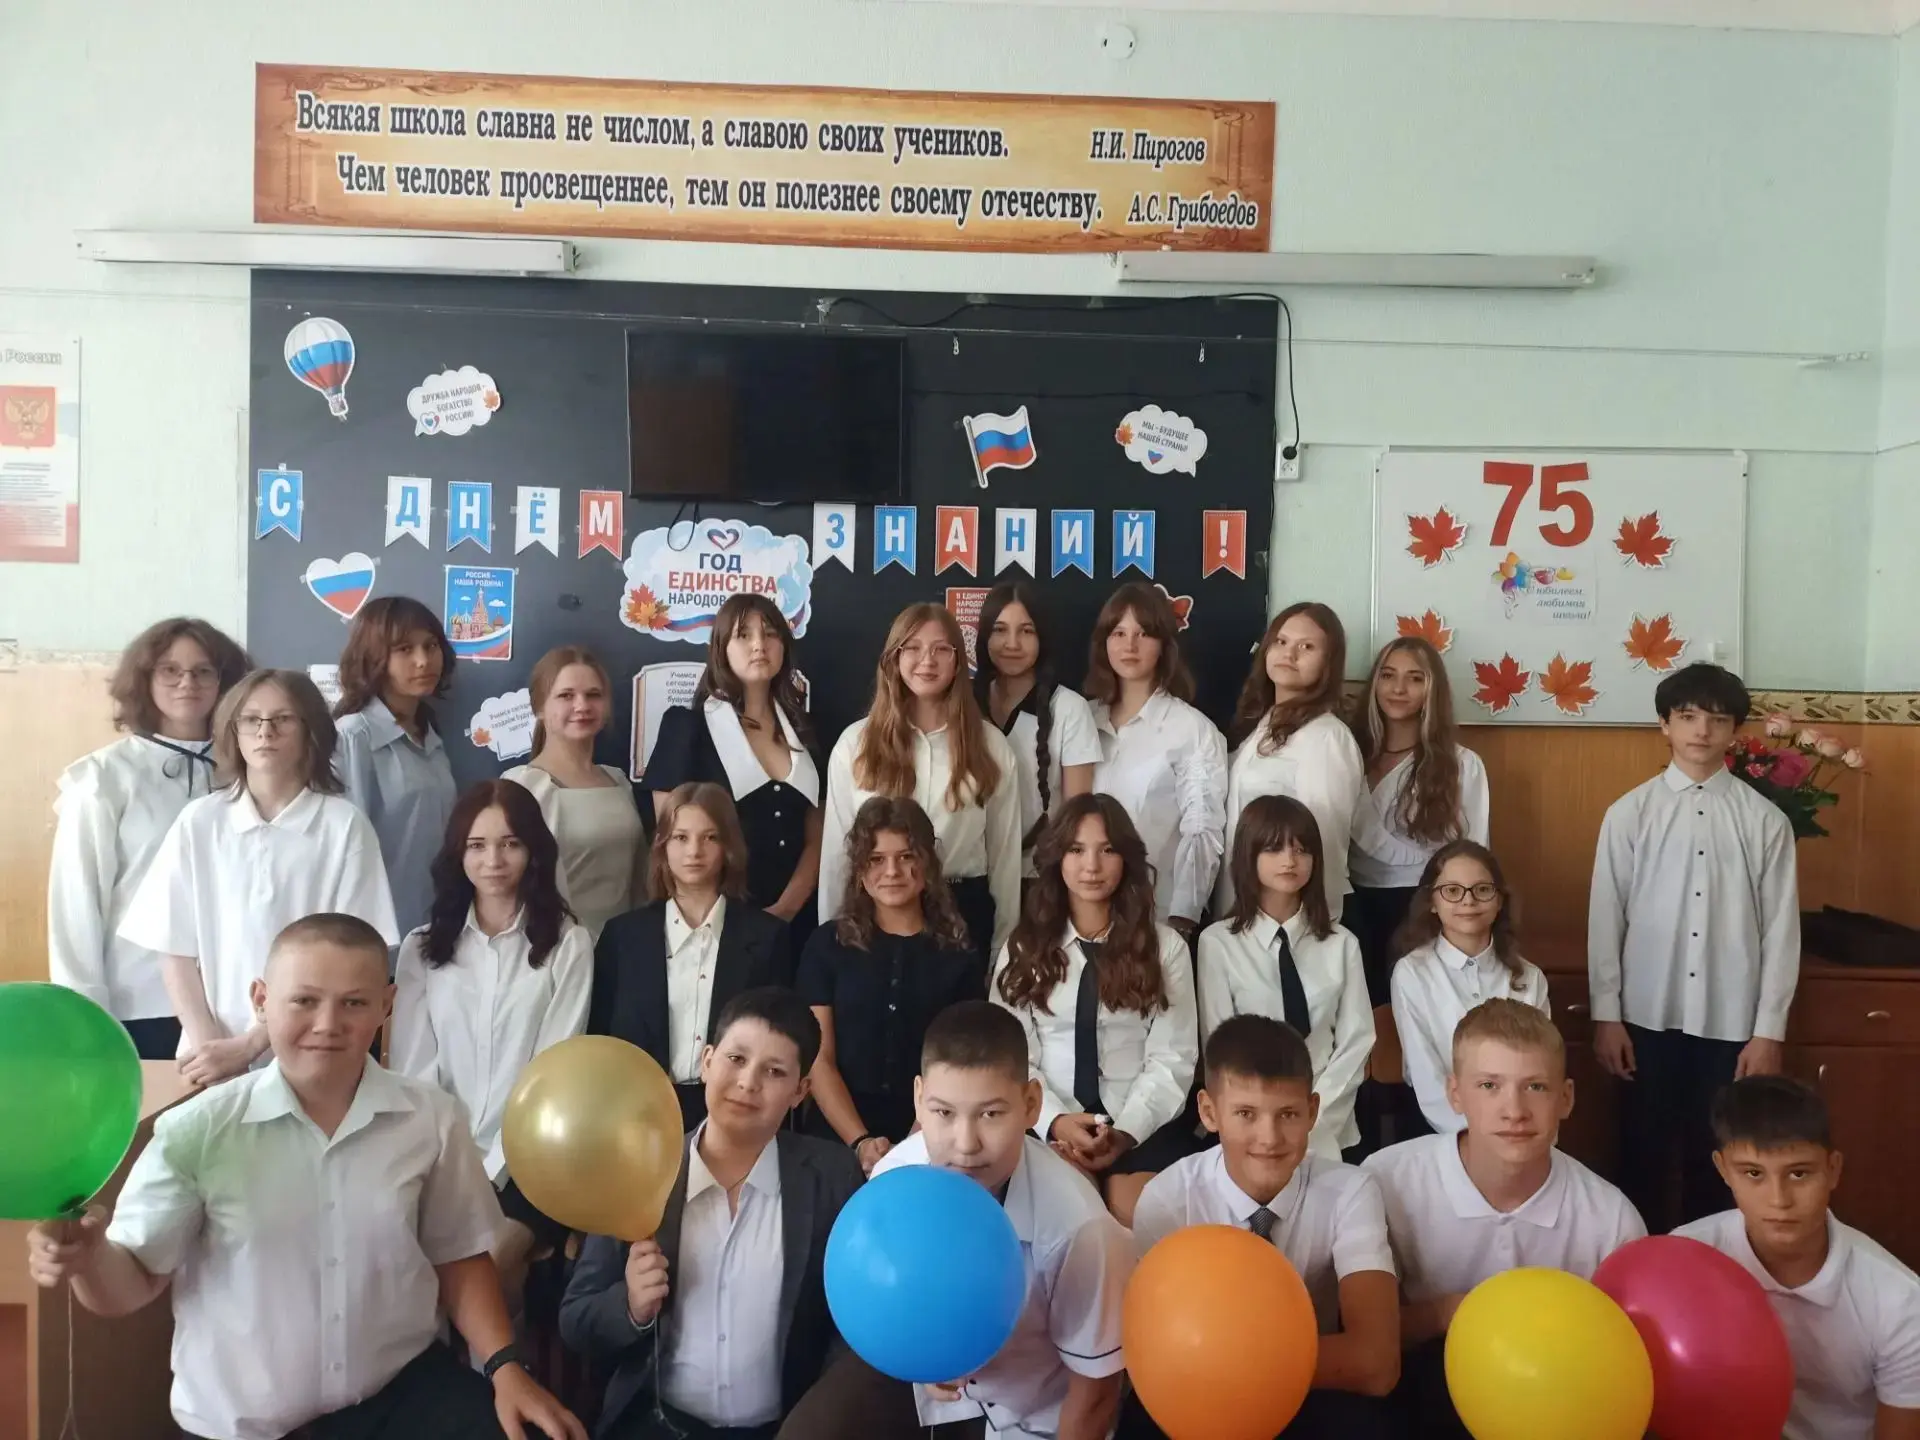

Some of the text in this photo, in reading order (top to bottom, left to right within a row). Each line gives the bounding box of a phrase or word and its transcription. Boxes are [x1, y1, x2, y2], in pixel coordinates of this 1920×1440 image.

[297, 93, 1009, 164] Всякая школа славна не числом, а славою своих учеников.
[1090, 131, 1206, 168] Н.И. Пирогов
[338, 155, 1102, 229] Чем человек просвещеннее, тем он полезнее своему отечеству.
[1128, 194, 1257, 229] А.С. Грибоедов
[421, 391, 450, 405] ДРУЖБА
[450, 383, 482, 397] НАРОДОВ
[436, 398, 473, 412] БОГАТСТВО
[1137, 431, 1161, 445] НАШЕЙ
[1142, 420, 1154, 431] МЫ
[1159, 426, 1189, 441] БУДУЩЕЕ
[1483, 461, 1594, 547] 75
[699, 553, 742, 573] ГОД
[454, 577, 474, 586] НАША
[668, 571, 777, 594] ЕДИНСТВА
[668, 593, 725, 608] НАРОДОВ
